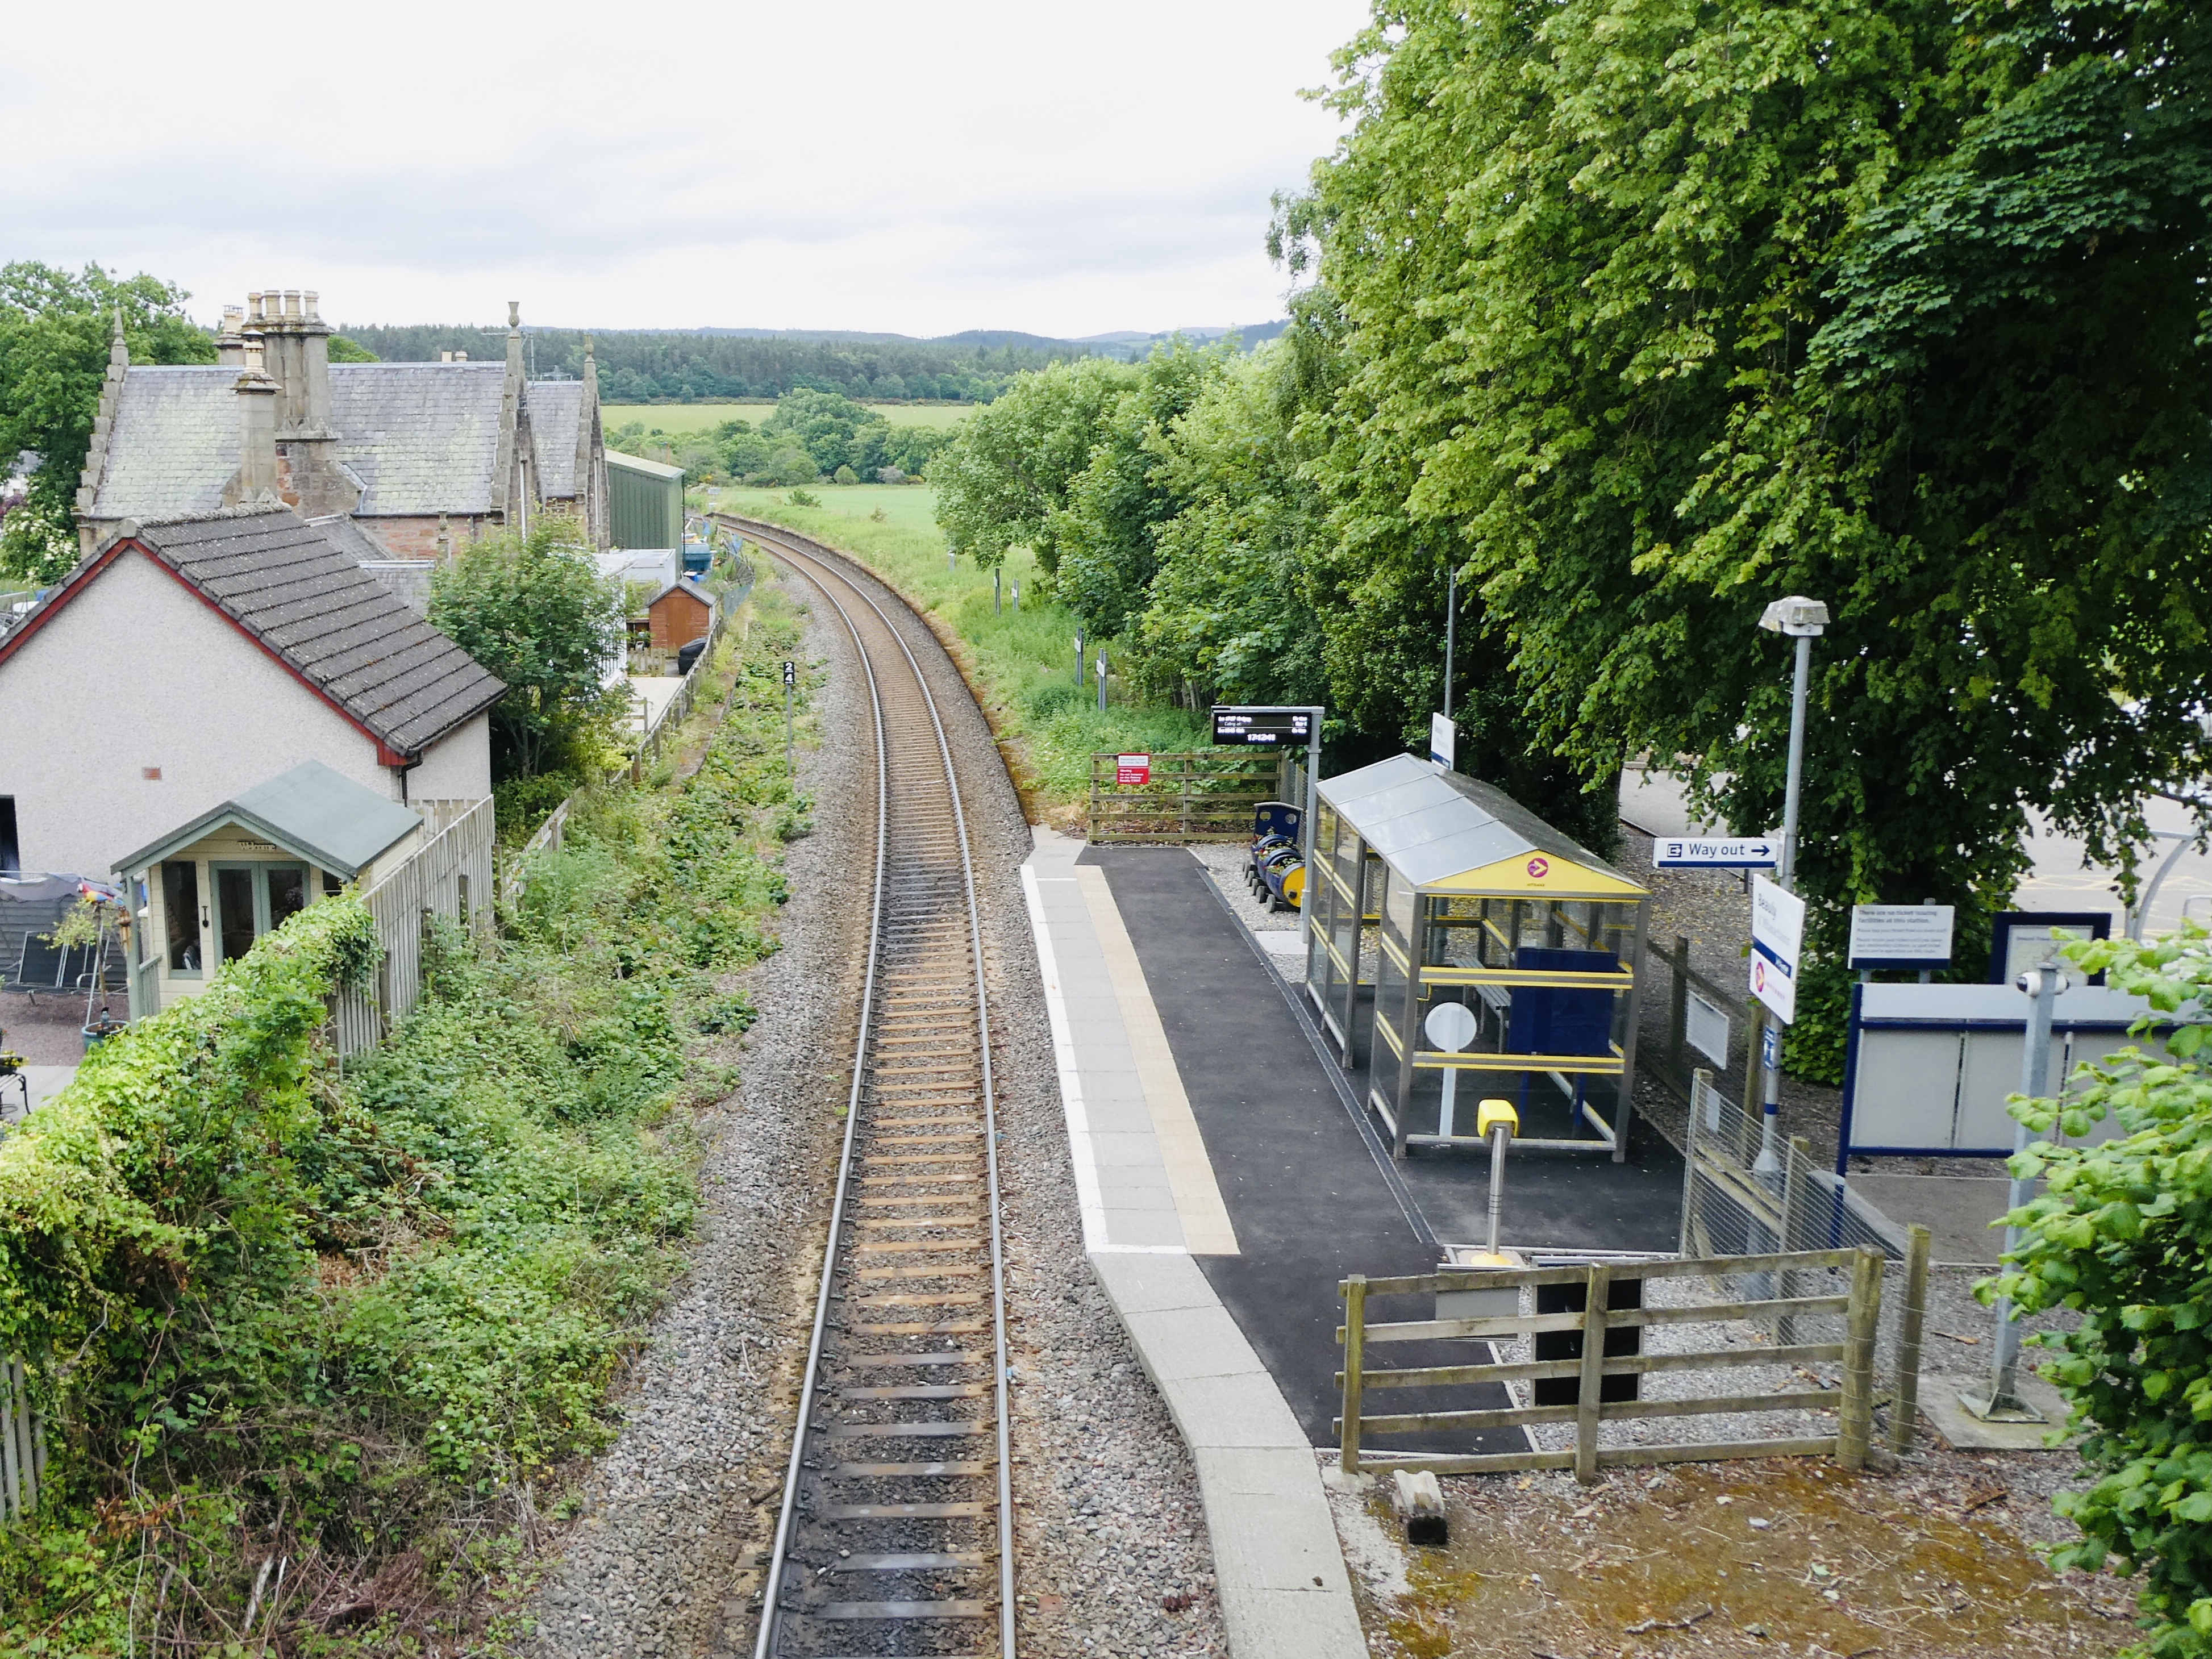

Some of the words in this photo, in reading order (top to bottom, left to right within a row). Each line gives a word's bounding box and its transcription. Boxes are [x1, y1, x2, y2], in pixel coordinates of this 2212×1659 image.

[785, 662, 793, 670] 2
[785, 673, 793, 682] 4
[238, 841, 276, 851] Welcome
[1689, 843, 1717, 858] Way
[1721, 844, 1745, 855] out
